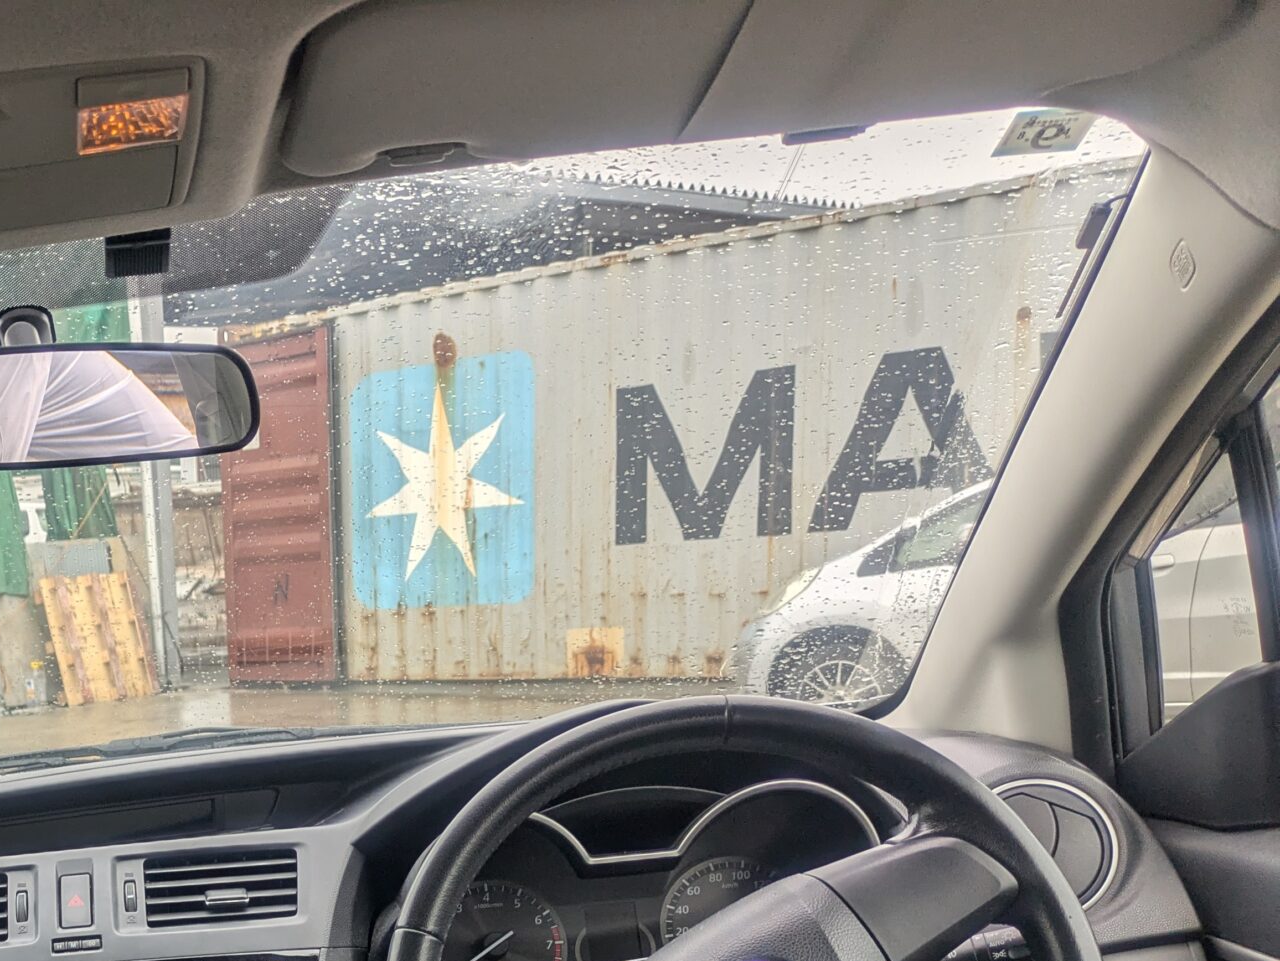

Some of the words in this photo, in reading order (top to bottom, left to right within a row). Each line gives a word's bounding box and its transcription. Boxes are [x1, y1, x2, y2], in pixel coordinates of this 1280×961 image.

[708, 872, 722, 882] 80
[731, 870, 751, 880] 100
[686, 885, 701, 896] 60
[482, 892, 490, 902] 4
[514, 898, 521, 908] 5
[675, 904, 690, 914] 40
[534, 915, 542, 925] 6
[546, 939, 553, 950] 7
